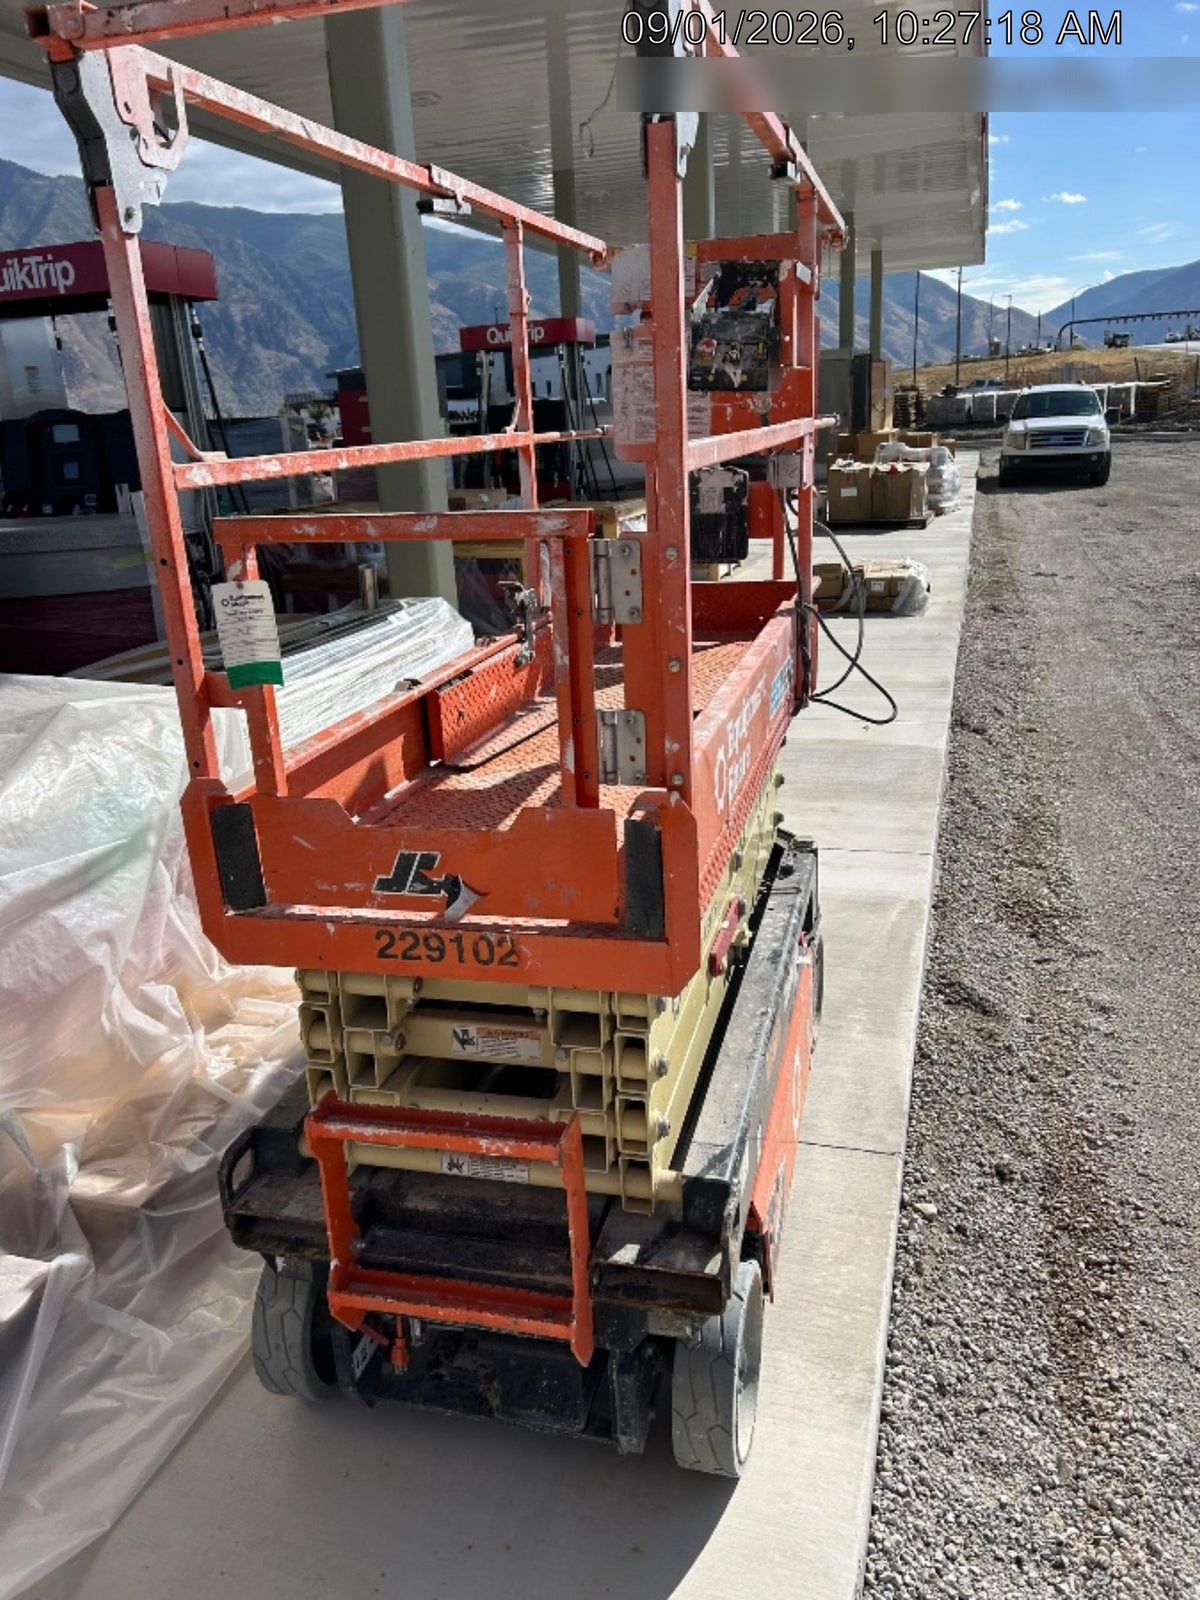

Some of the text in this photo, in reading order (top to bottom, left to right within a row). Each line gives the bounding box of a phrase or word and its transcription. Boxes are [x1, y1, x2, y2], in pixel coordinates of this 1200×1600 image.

[0, 254, 75, 294] uikTrip
[486, 325, 545, 343] Quiip
[375, 929, 519, 967] 229102
